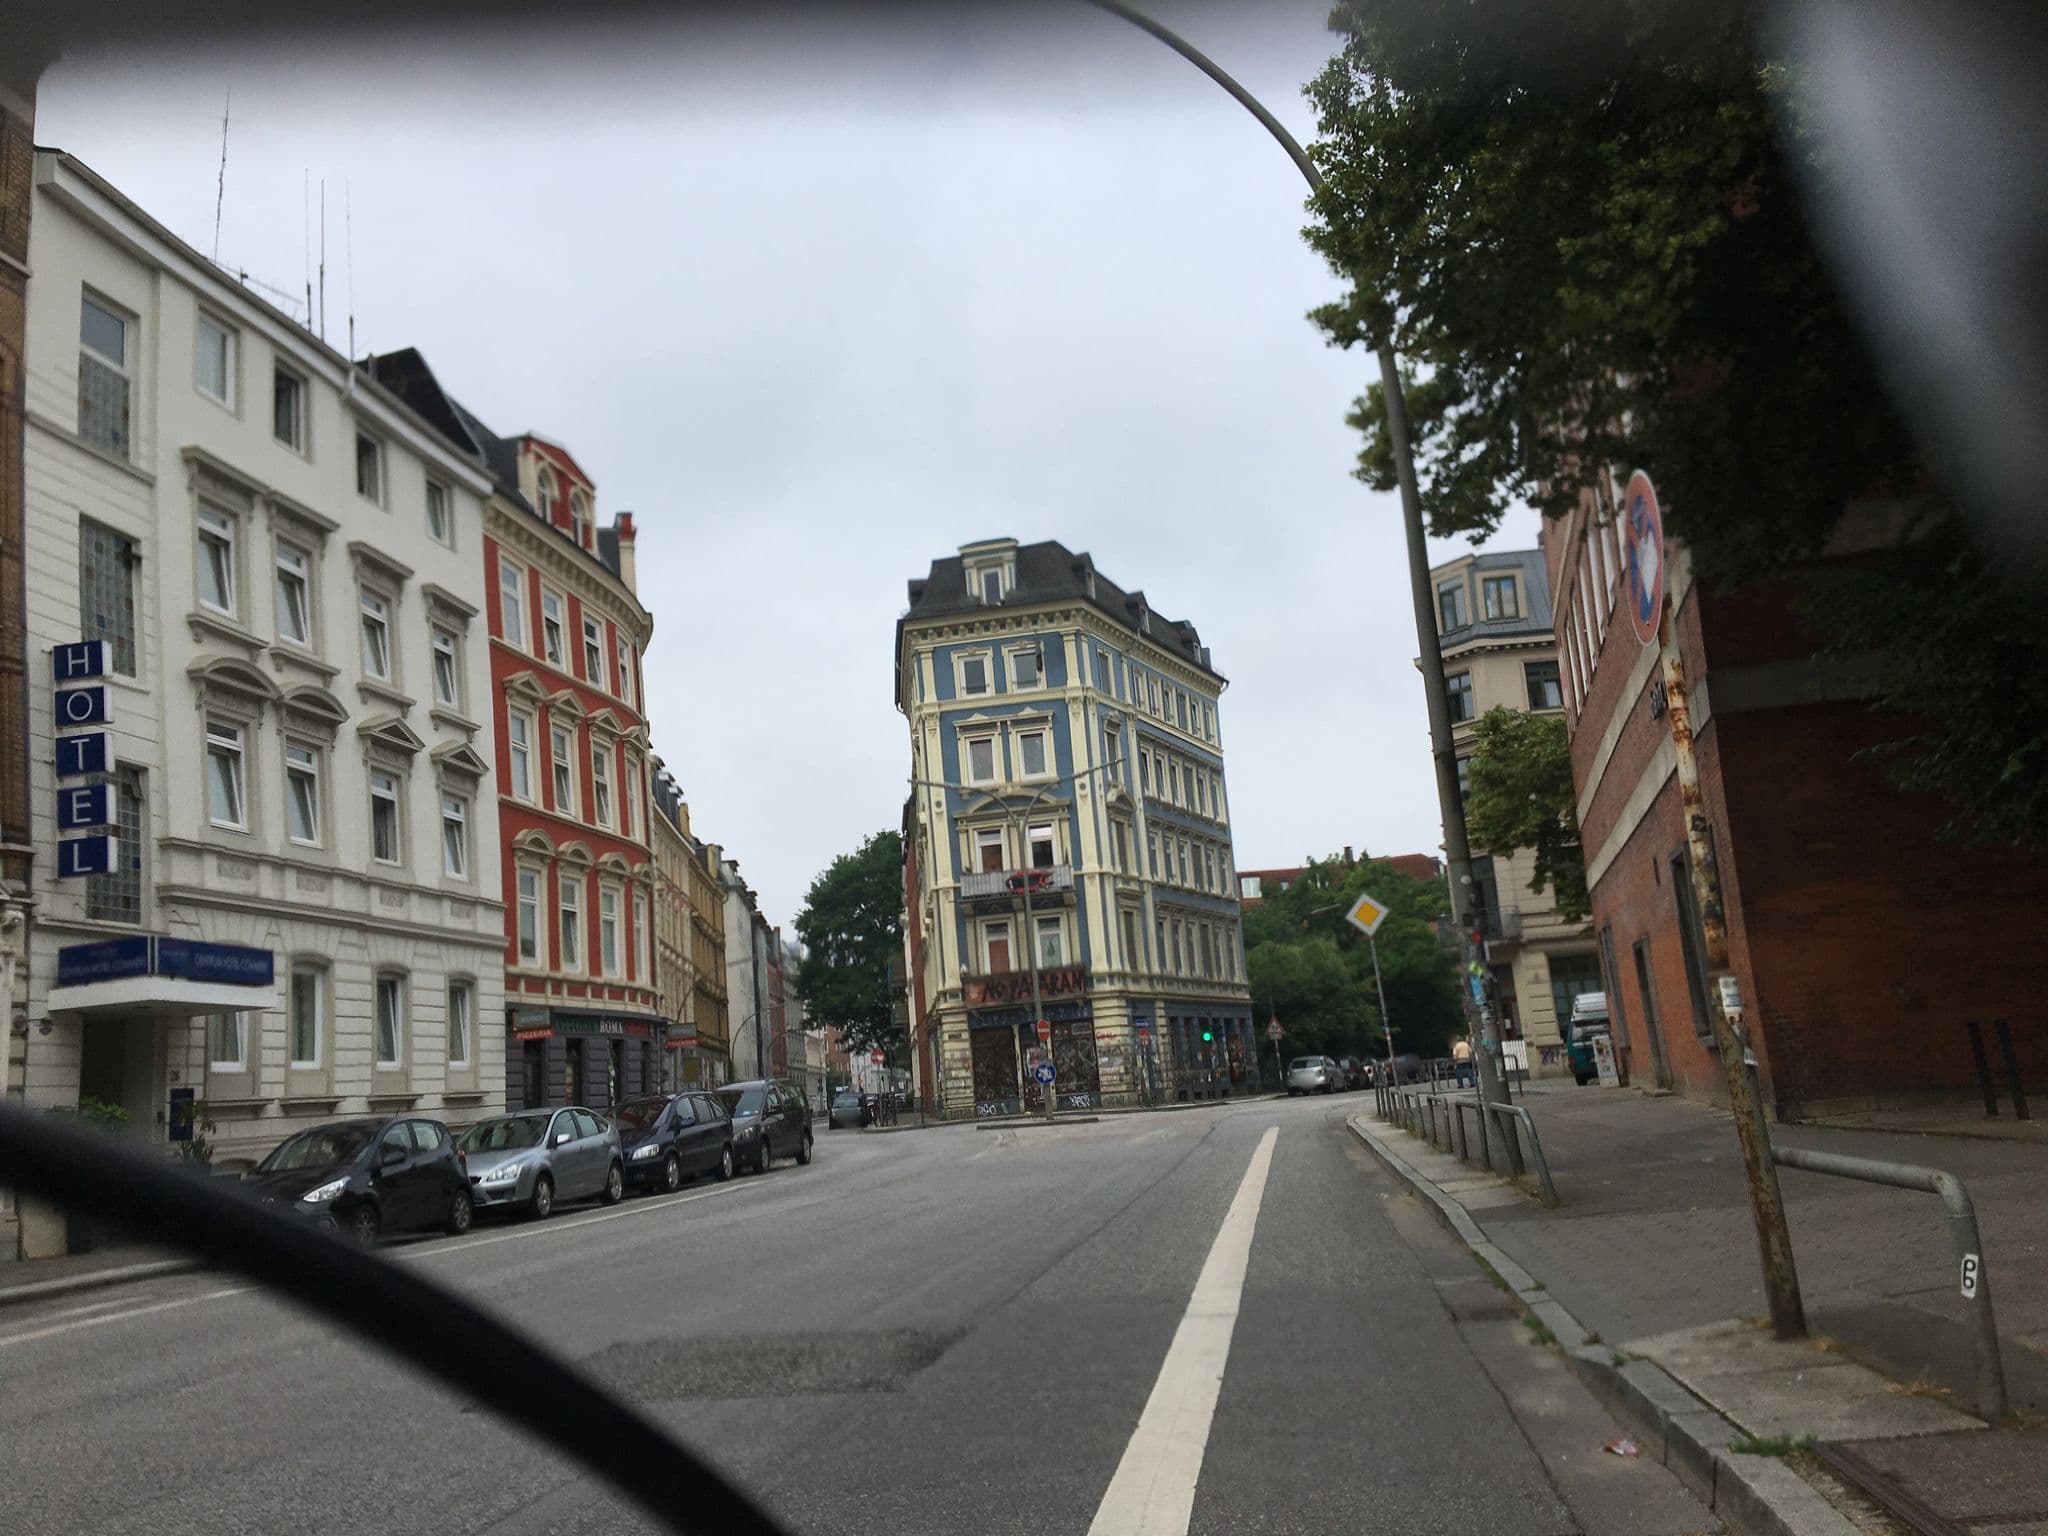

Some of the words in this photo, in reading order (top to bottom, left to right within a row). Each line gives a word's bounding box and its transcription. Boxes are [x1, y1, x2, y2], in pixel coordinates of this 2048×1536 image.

[66, 645, 93, 872] HOTEL
[599, 1020, 624, 1034] ROMA
[516, 1029, 553, 1040] PIZZERIA
